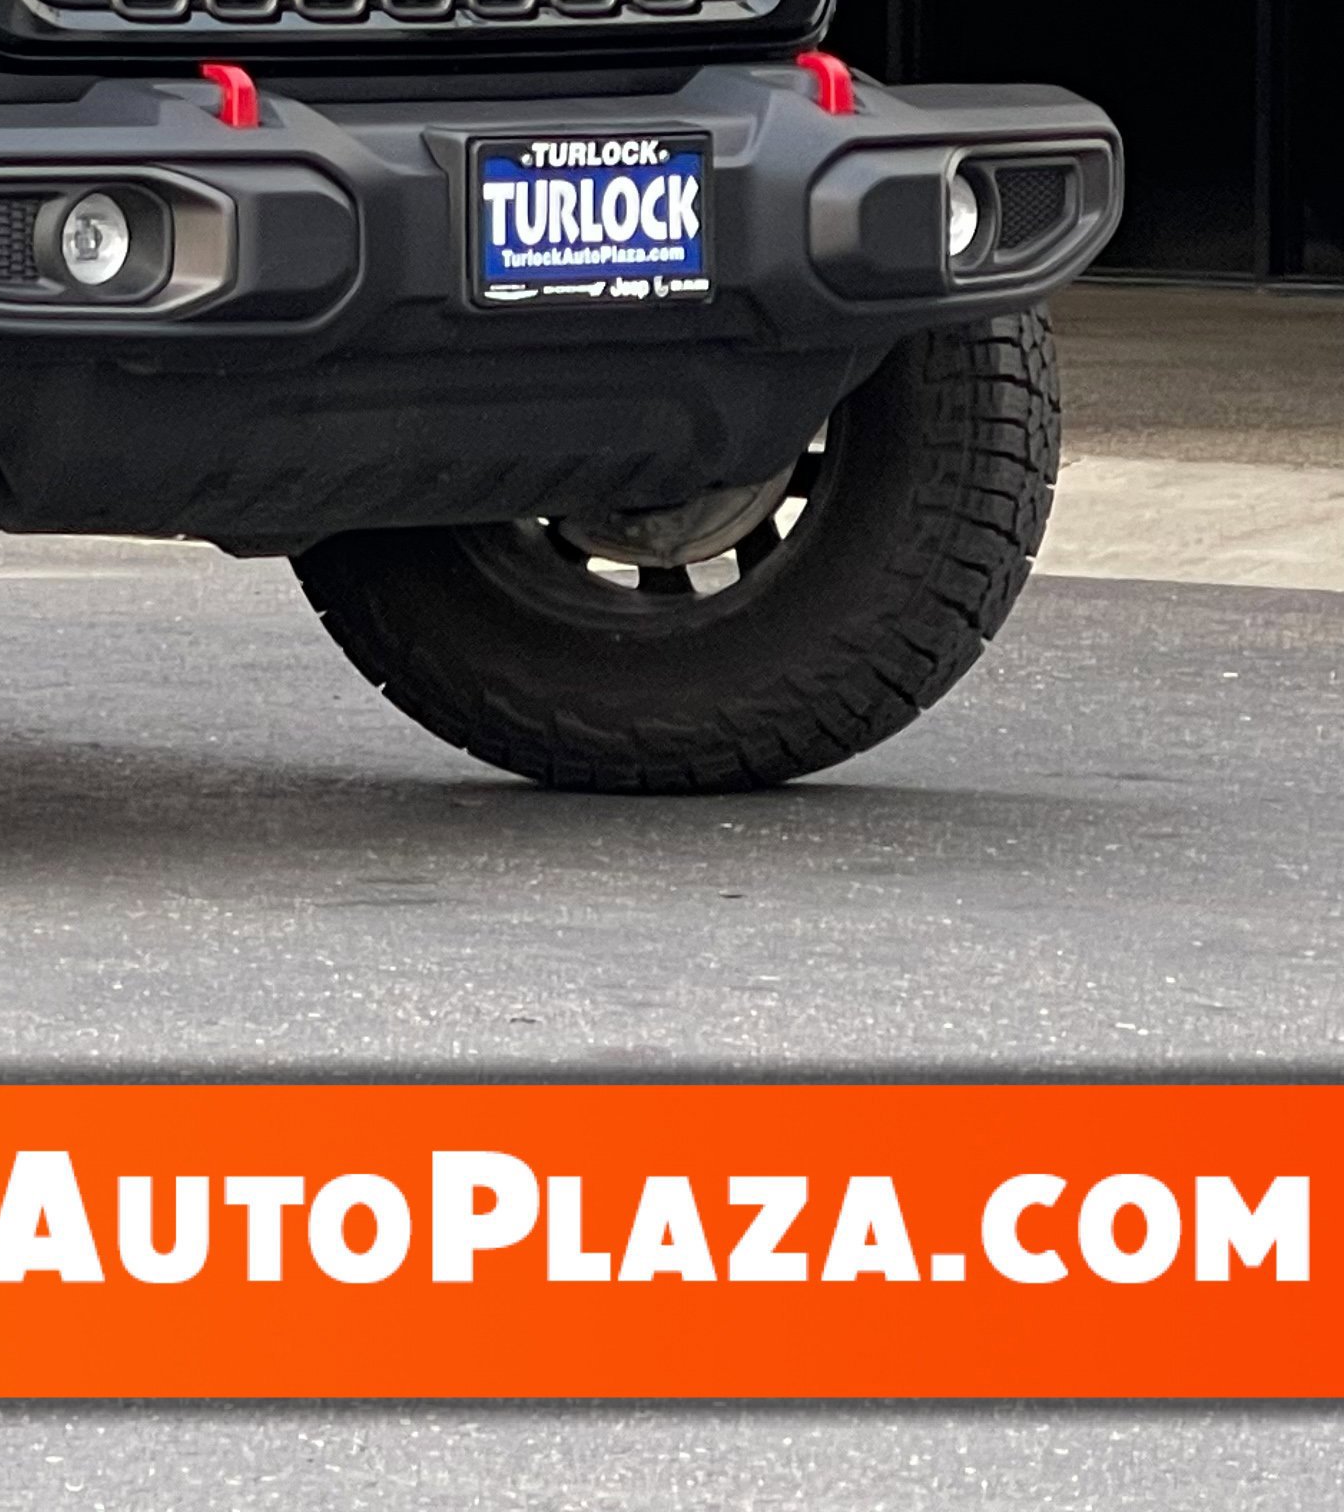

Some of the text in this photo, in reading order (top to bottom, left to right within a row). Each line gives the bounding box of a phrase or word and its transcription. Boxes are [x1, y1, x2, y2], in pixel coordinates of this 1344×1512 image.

[531, 140, 660, 168] TURLOCK
[482, 174, 701, 246] TURLOCK
[501, 246, 685, 268] TurlockAutoPlaza.com
